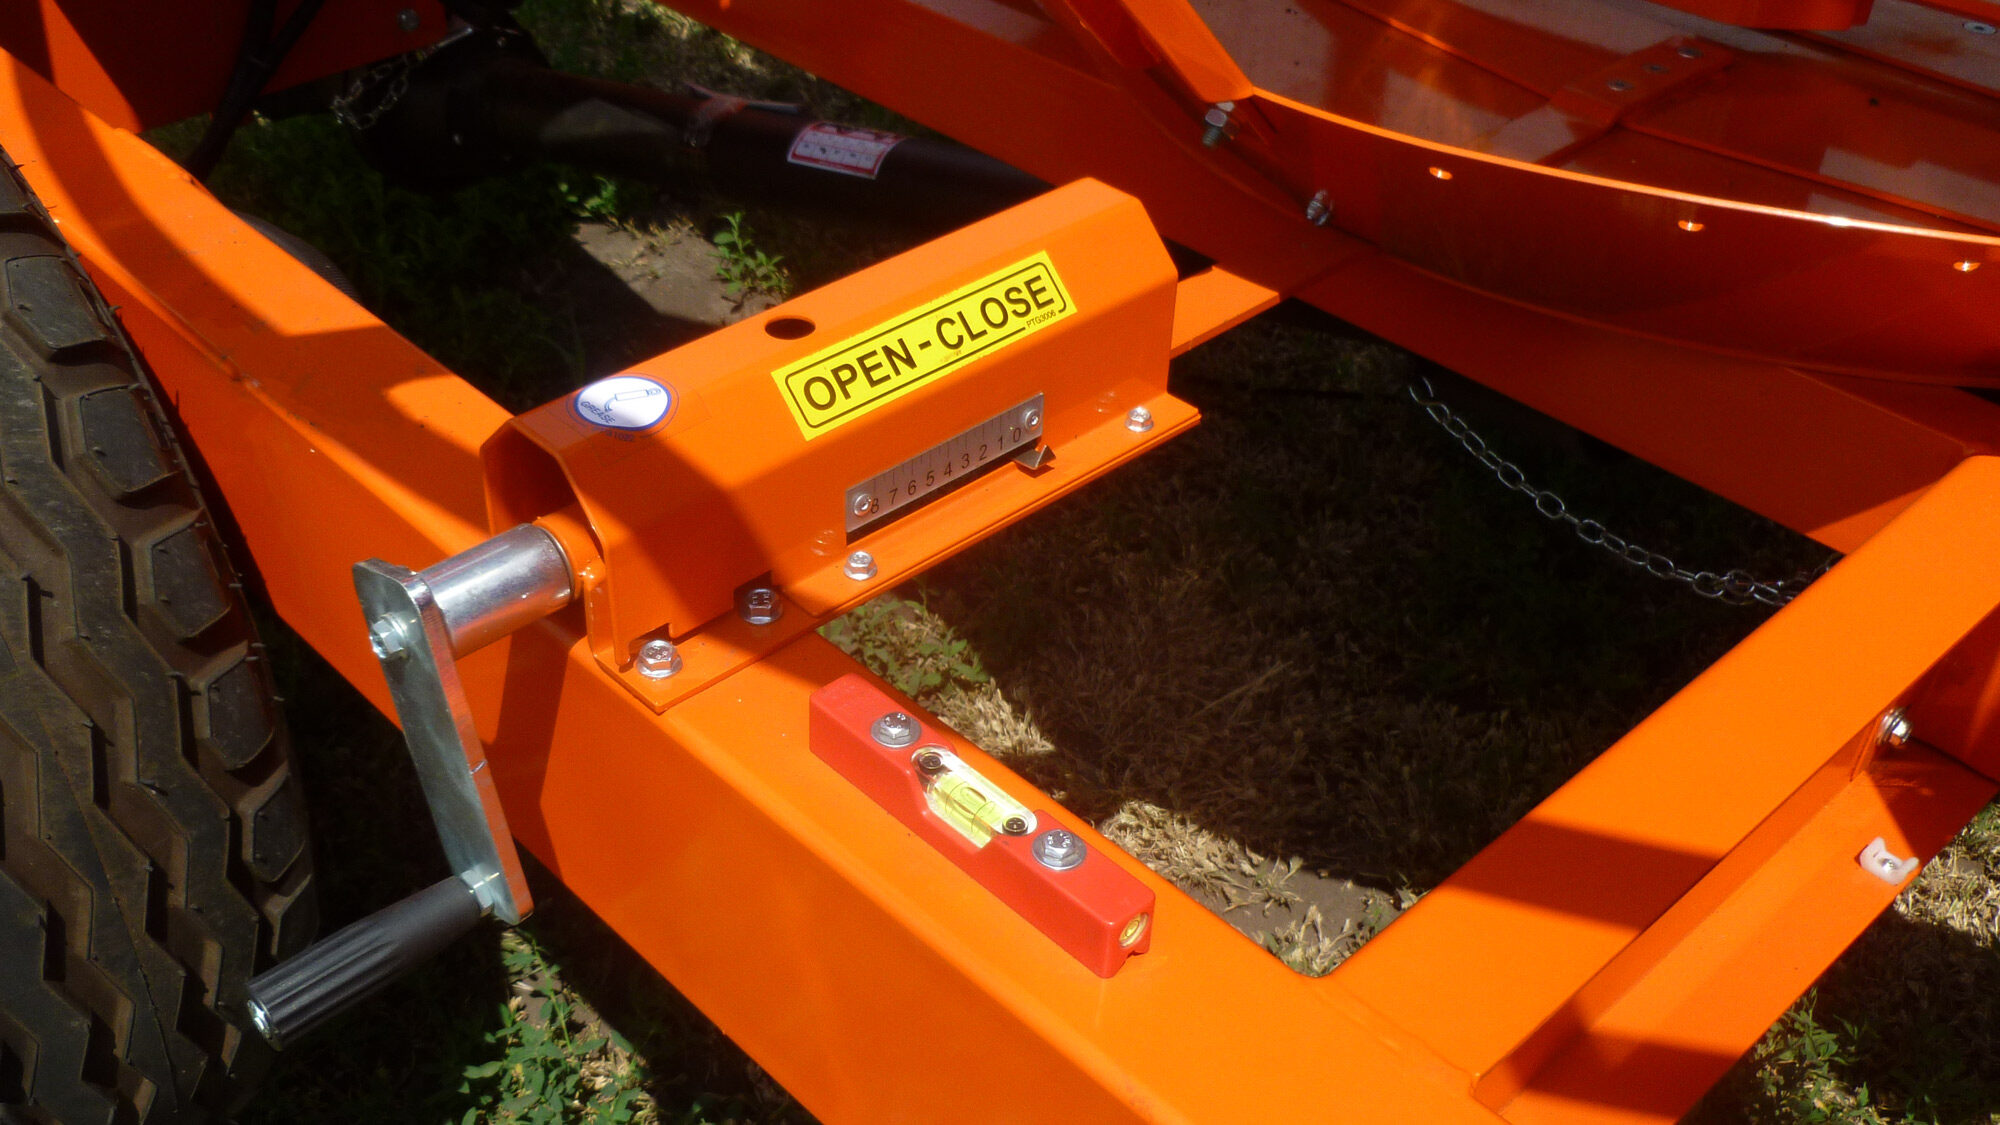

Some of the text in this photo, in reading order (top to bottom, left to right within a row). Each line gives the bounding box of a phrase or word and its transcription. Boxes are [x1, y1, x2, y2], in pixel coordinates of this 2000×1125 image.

[803, 337, 918, 411] OPEN
[935, 274, 1055, 350] CLOSE
[1026, 309, 1056, 328] PTG3006
[580, 400, 616, 424] GREASE
[870, 427, 1022, 514] 8 7 6 5 4 3 2 1 0
